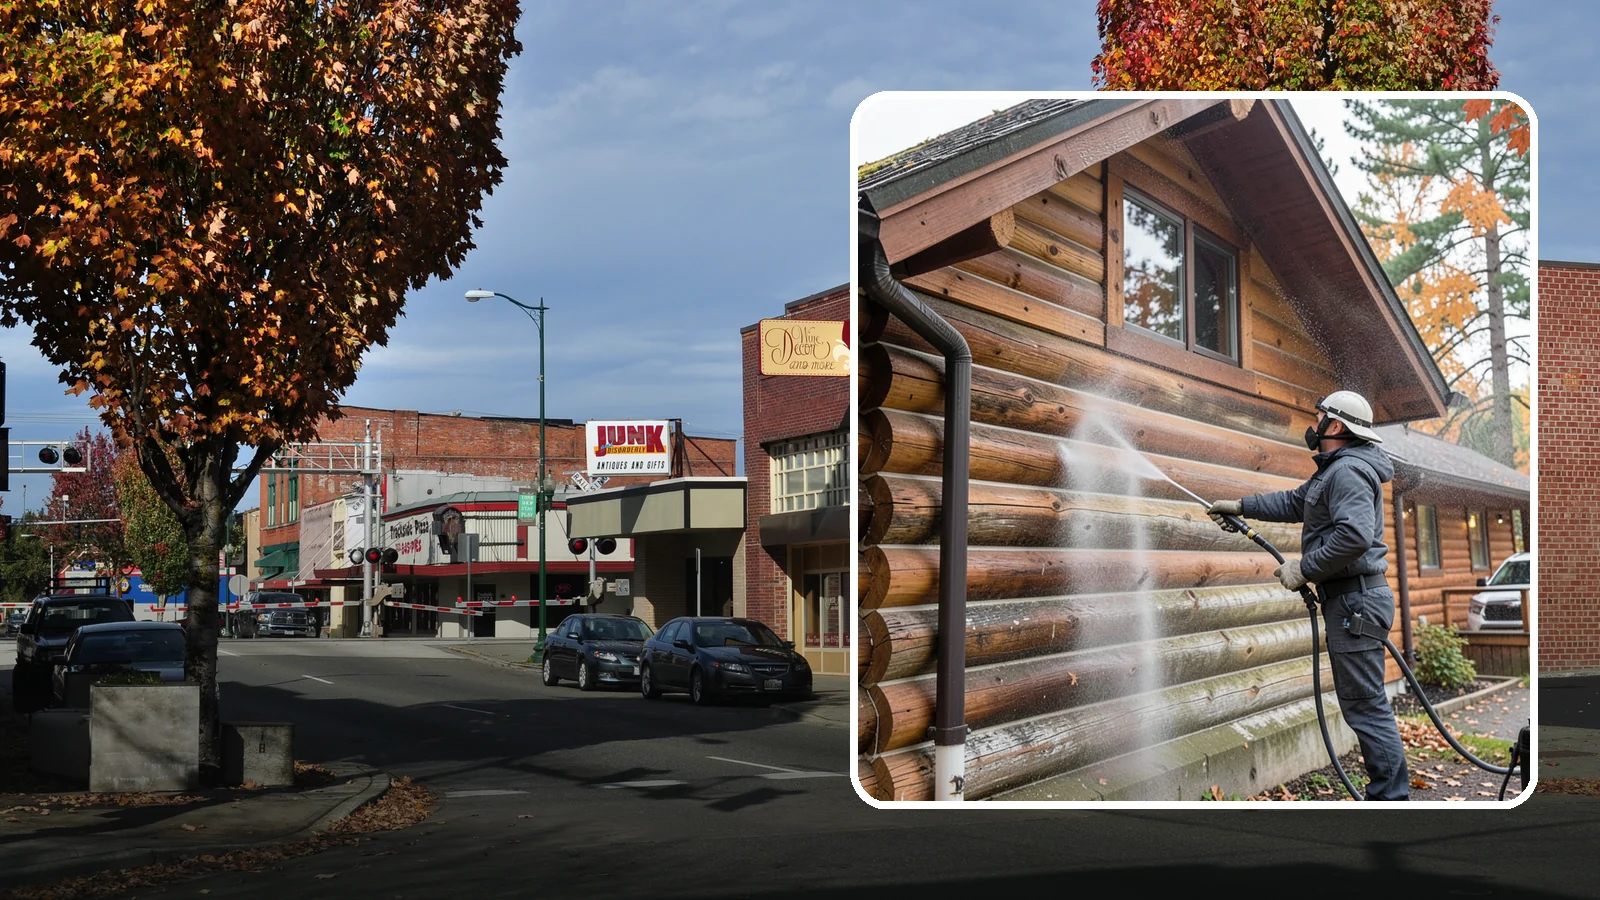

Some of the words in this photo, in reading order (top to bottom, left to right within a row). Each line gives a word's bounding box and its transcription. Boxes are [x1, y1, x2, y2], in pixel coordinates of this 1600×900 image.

[595, 425, 665, 457] JUNK
[607, 446, 646, 454] DISORDERLY
[597, 461, 628, 470] ANTIQUES
[631, 461, 644, 469] AND
[647, 460, 665, 469] GIFTS
[573, 473, 588, 491] RAIL
[390, 522, 412, 539] Trackside
[414, 519, 429, 535] Pizza
